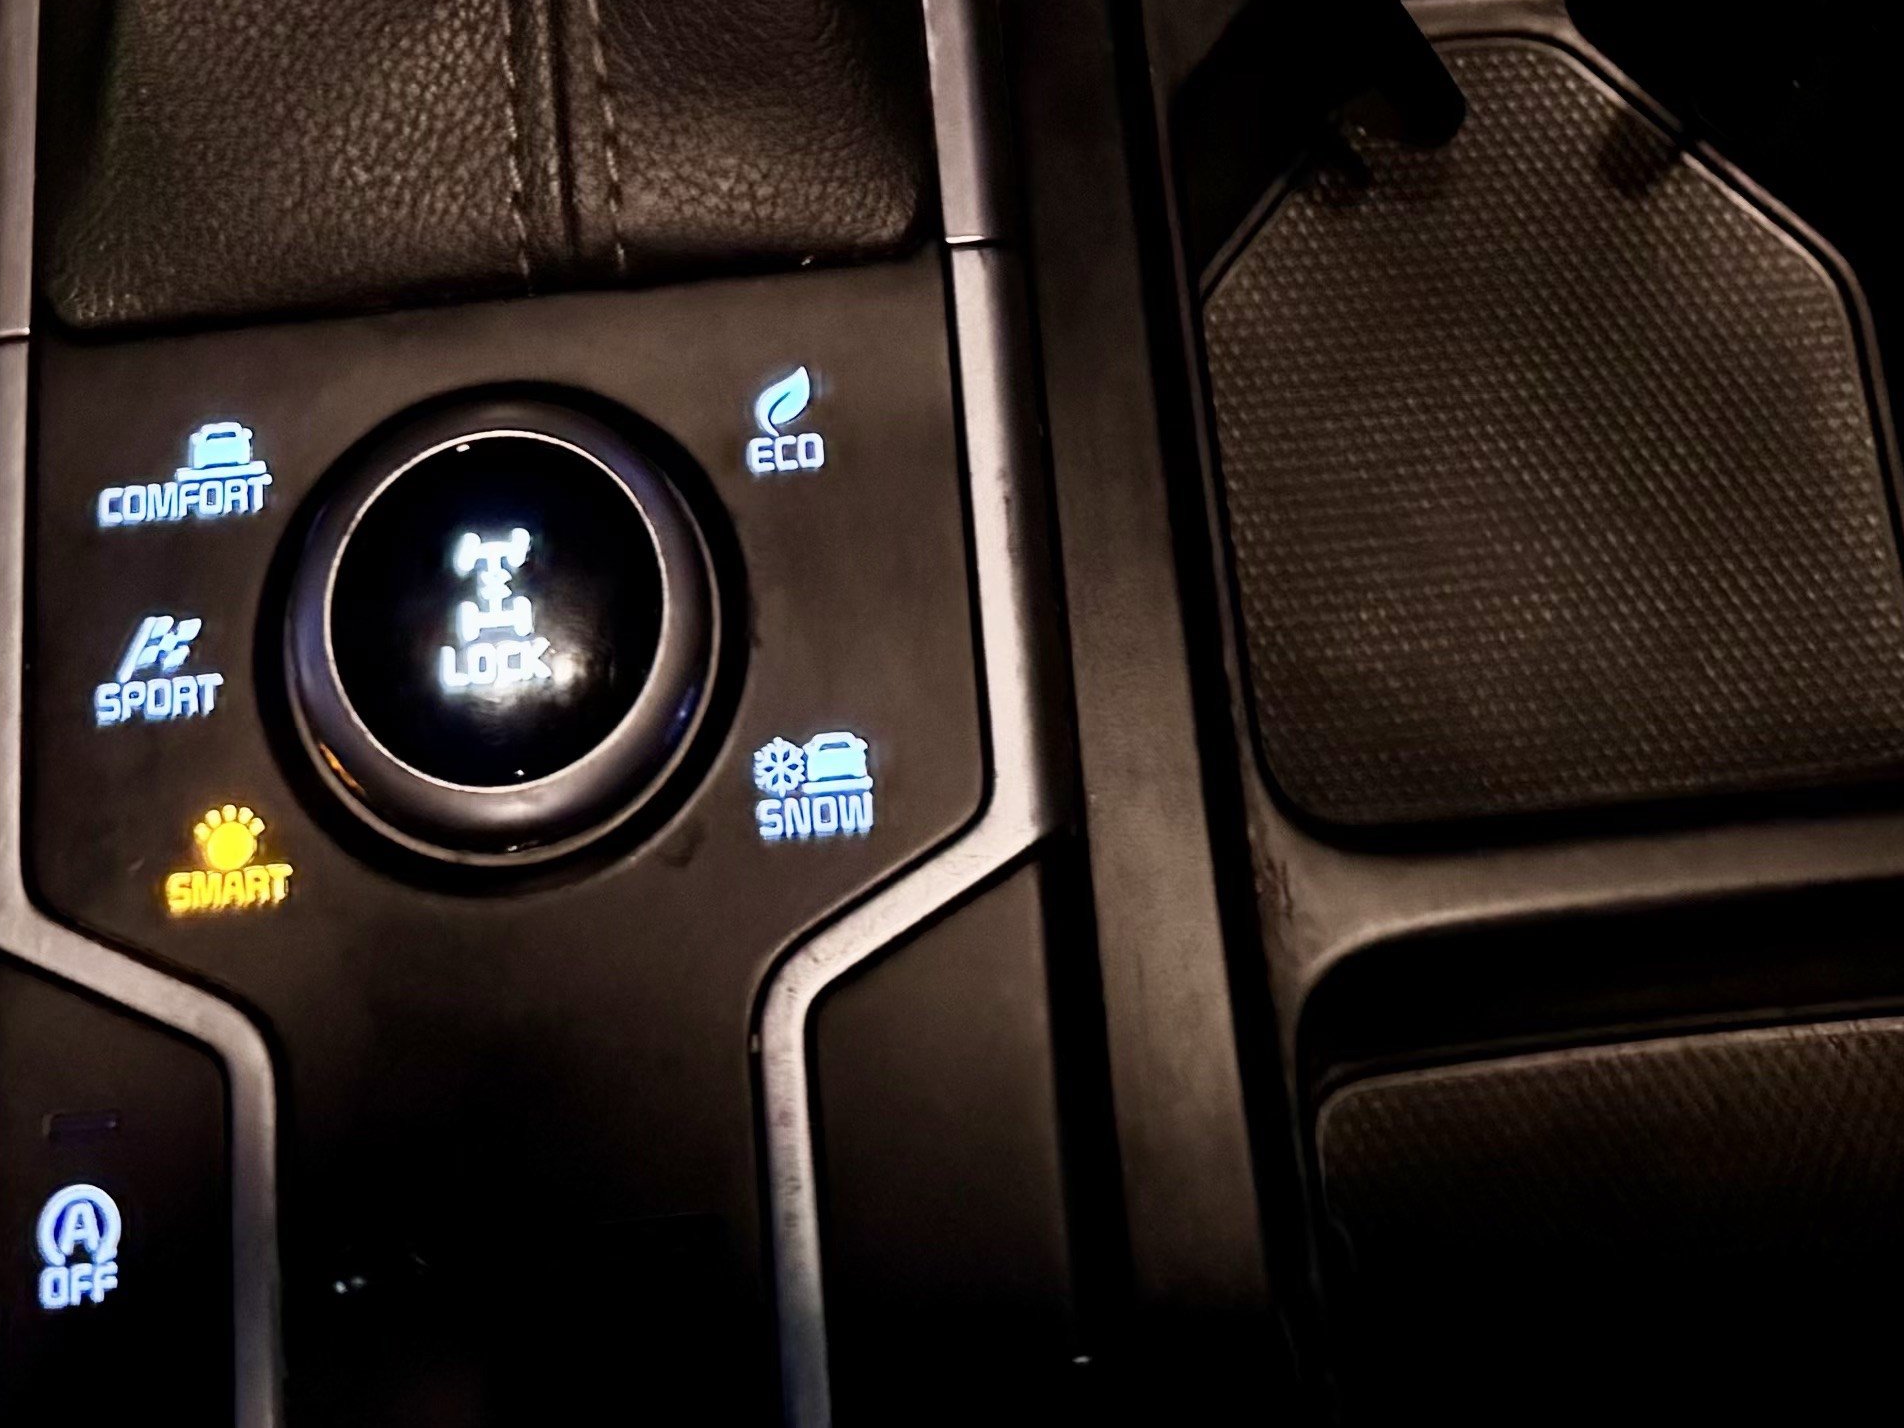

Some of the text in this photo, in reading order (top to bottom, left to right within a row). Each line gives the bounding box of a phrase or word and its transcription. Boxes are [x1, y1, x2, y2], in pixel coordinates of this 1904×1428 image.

[747, 432, 825, 473] ECO
[98, 473, 273, 526] COMFORT
[439, 637, 552, 689] LOCK
[95, 673, 224, 726] SPORT
[756, 791, 874, 840] SNOW
[166, 863, 294, 914] SMART
[39, 1260, 119, 1310] OFF
